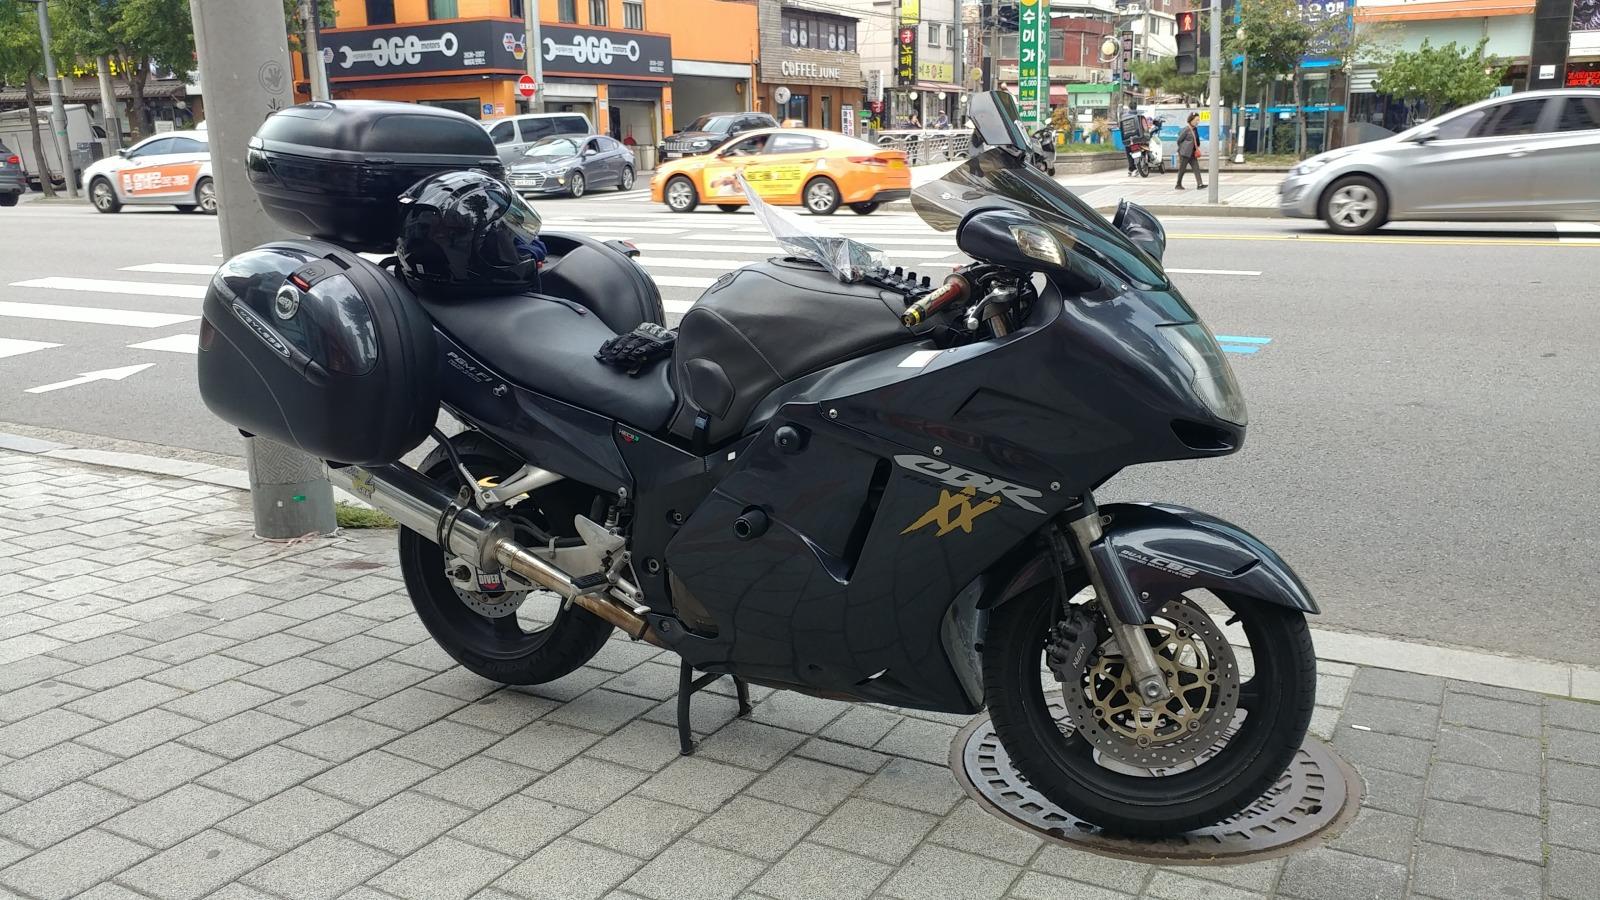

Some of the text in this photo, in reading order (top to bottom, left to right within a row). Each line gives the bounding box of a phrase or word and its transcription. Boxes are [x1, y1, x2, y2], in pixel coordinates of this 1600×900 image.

[1022, 8, 1035, 63] 수미가
[781, 61, 841, 79] COFFEE JUNE
[893, 454, 1049, 515] CBR
[899, 484, 1002, 537] XX
[1121, 549, 1200, 576] DUAL CBS
[478, 574, 501, 585] DIVER
[1072, 641, 1087, 669] NISSIN
